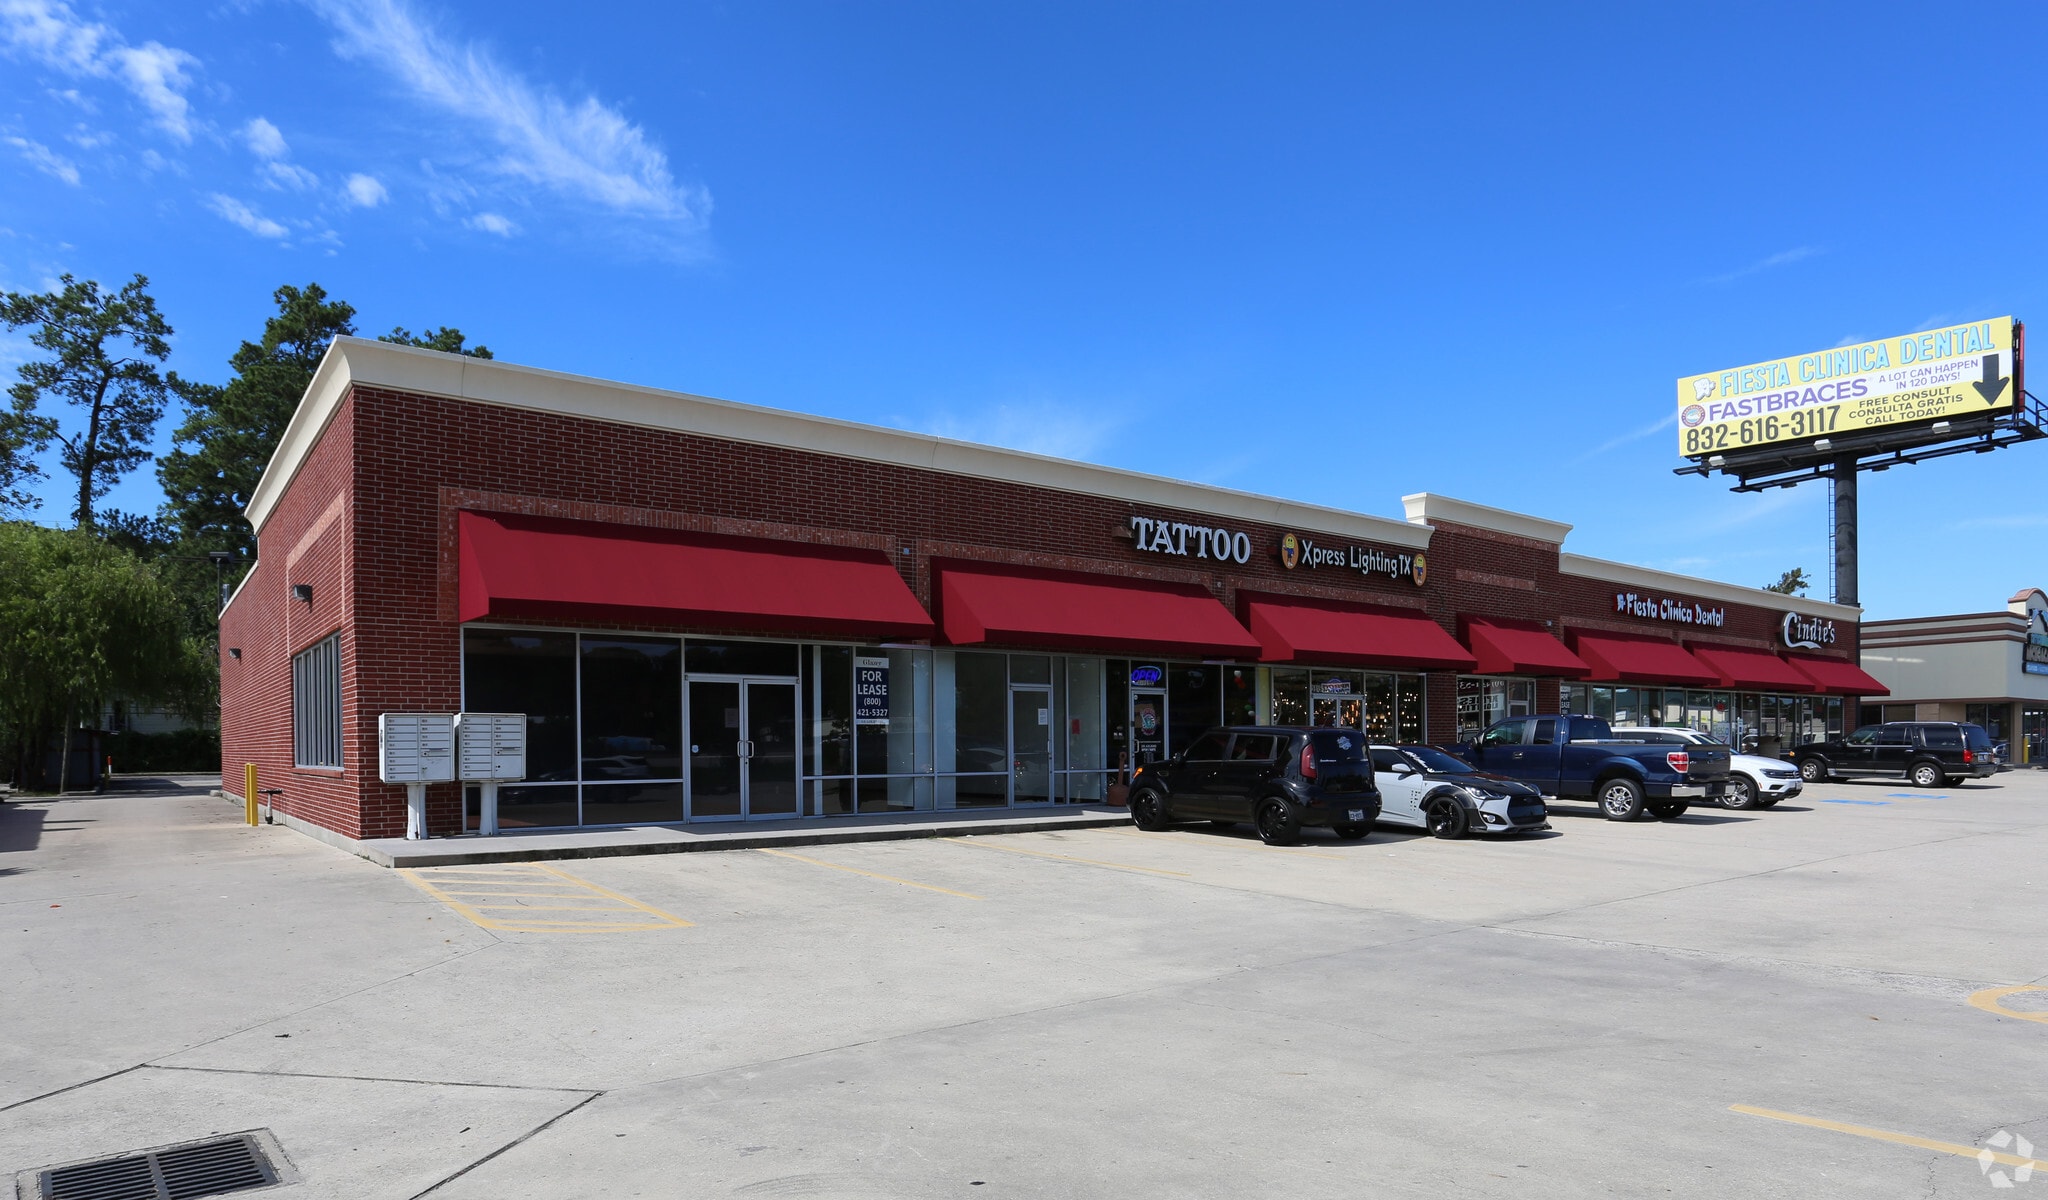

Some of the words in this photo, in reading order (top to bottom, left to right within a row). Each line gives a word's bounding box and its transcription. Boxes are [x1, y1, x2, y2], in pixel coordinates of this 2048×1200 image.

[1719, 362, 1790, 397] FIESTA
[1798, 343, 1890, 382] CLINICA
[1900, 323, 1995, 365] DENTAL
[1878, 375, 1886, 383] A
[1889, 371, 1907, 382] LOT
[1910, 367, 1932, 378] CAN
[1935, 359, 1979, 374] HAPPEN
[1896, 381, 1906, 390] IN
[1910, 378, 1928, 387] 120
[1930, 372, 1961, 384] DAYS!
[1709, 378, 1868, 421] FASTBRACES
[1849, 403, 1913, 419] CONSULTA
[1917, 394, 1964, 408] GRATIS
[1859, 397, 1889, 408] FREE
[1893, 386, 1951, 403] CONSULT
[1865, 414, 1895, 425] CALL
[1900, 406, 1946, 420] TODAY!
[1686, 405, 1840, 452] 832-616-3117
[1132, 516, 1251, 564] TATTOO
[1301, 539, 1345, 568] Xpress
[1350, 546, 1398, 579] Lighting
[1398, 554, 1411, 575] TX
[1625, 592, 1658, 619] Fiesta
[1660, 598, 1692, 623] Clinica
[1694, 603, 1724, 628] Dental
[1783, 611, 1835, 649] Cindie's
[861, 670, 882, 682] FOR
[1132, 669, 1158, 682] OPEN
[857, 684, 887, 695] LEASE
[863, 697, 881, 706] (800)
[857, 708, 888, 717] 421-5327
